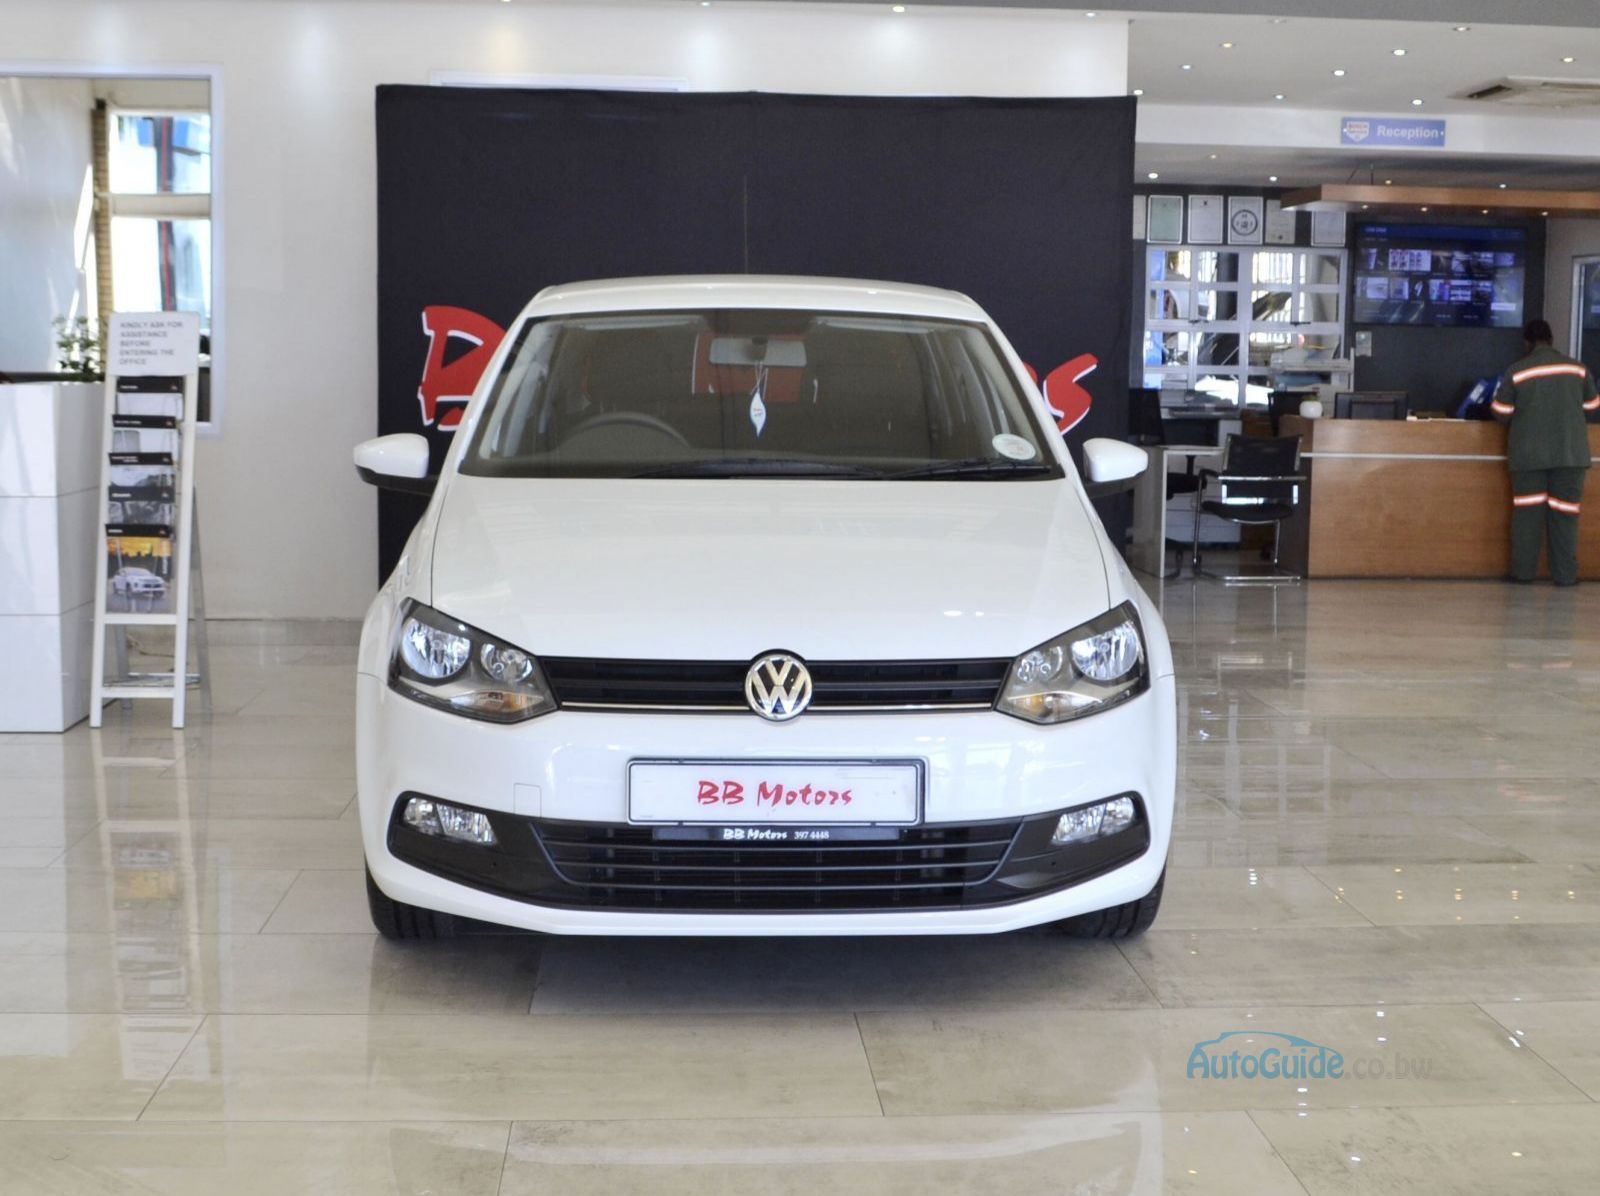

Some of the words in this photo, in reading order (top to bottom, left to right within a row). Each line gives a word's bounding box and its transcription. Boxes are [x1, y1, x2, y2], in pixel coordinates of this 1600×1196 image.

[1377, 125, 1439, 139] Reception
[698, 781, 744, 805] BB
[757, 781, 852, 807] Motors
[723, 828, 745, 840] BB
[747, 828, 788, 840] Motors
